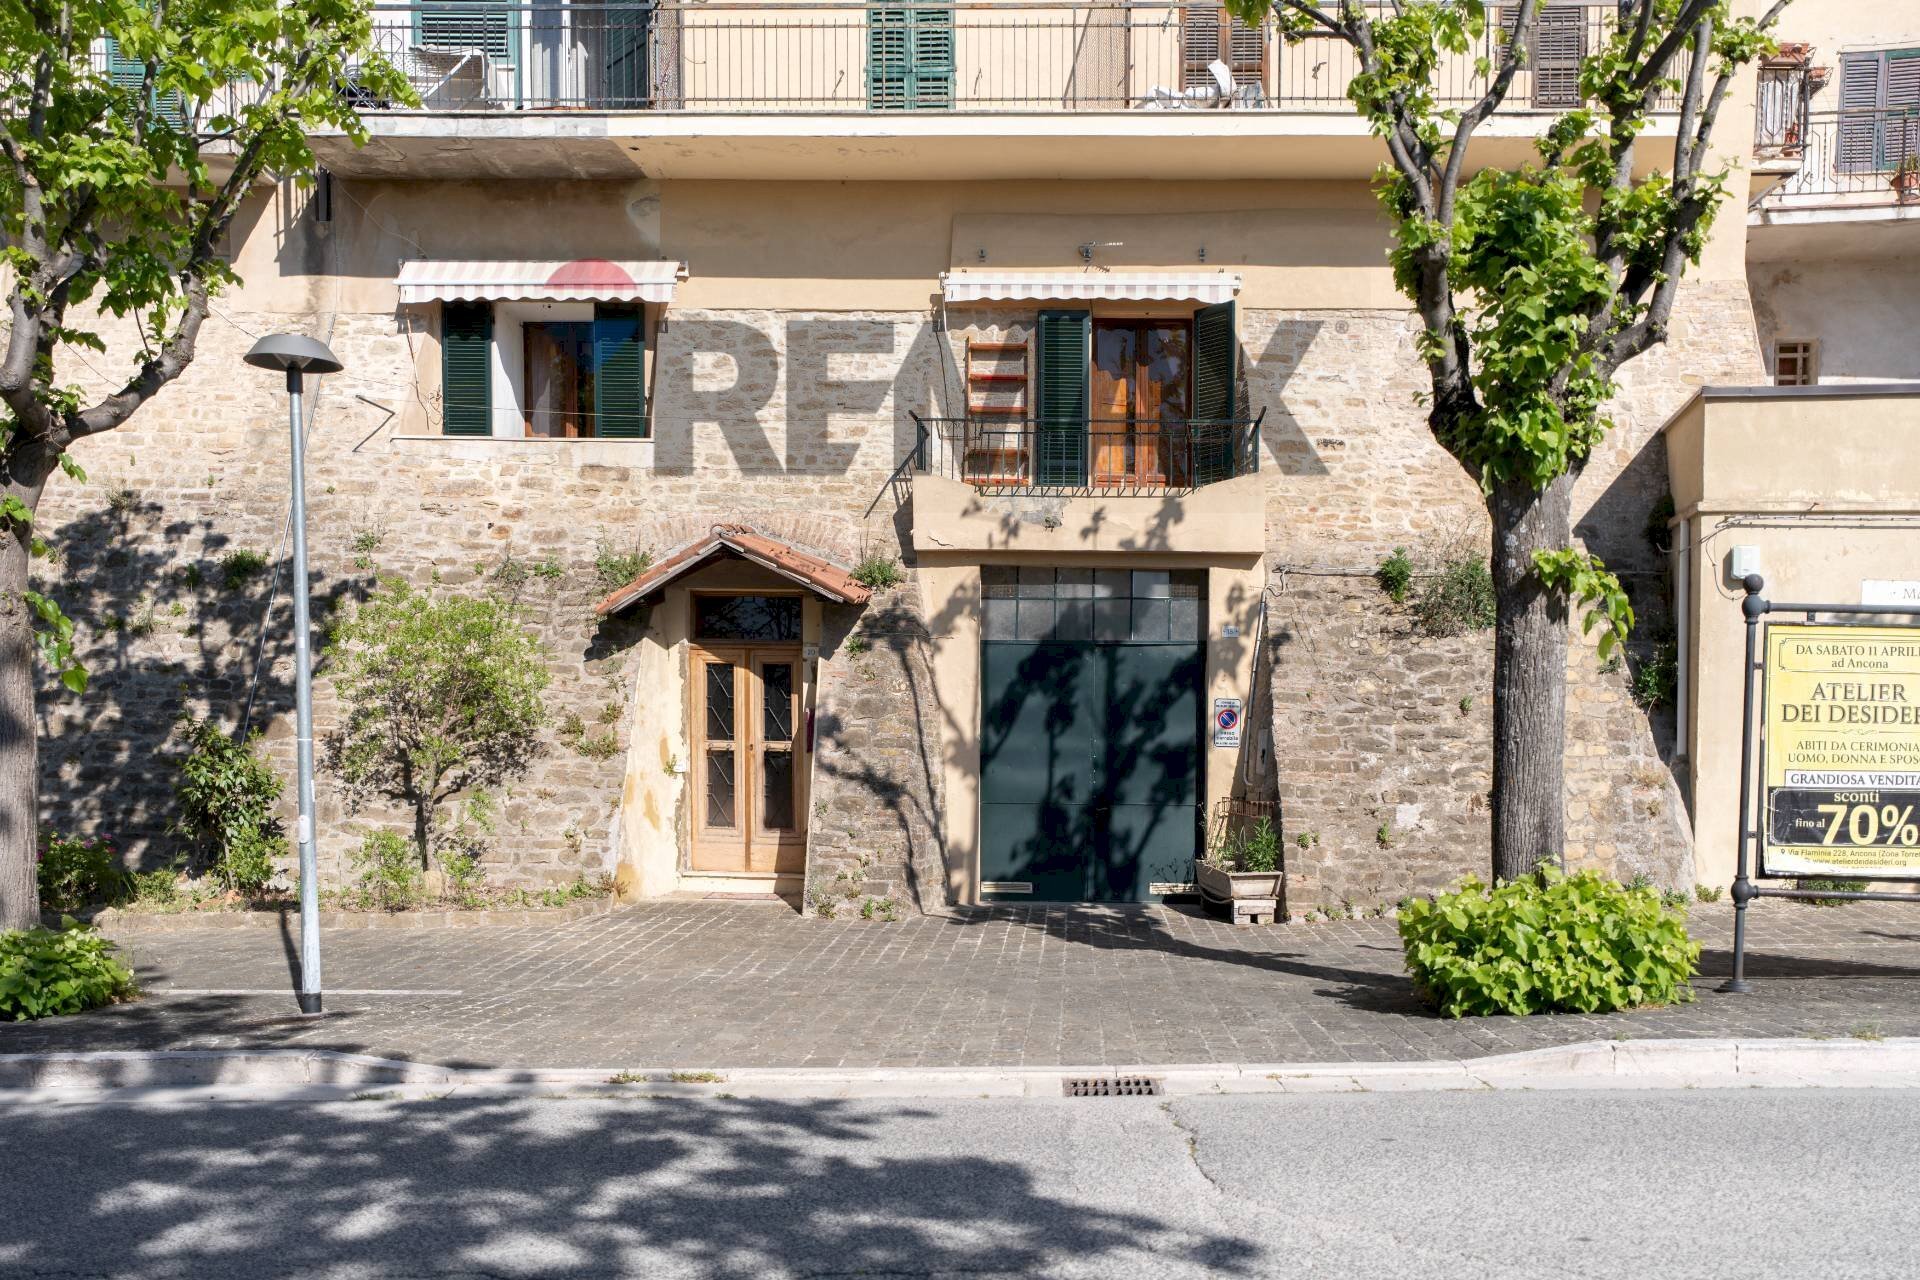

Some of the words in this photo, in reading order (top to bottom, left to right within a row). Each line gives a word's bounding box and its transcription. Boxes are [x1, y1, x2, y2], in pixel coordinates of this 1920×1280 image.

[1903, 588, 1920, 599] M
[1796, 644, 1813, 655] DA
[1816, 645, 1865, 656] SABATO
[1869, 646, 1877, 656] 11
[1881, 646, 1920, 657] APRIL
[1831, 658, 1845, 668] ad
[1847, 658, 1889, 669] Ancona
[1810, 681, 1908, 702] ATELIER
[1782, 703, 1821, 723] DEI
[1796, 740, 1828, 751] ABITI
[1831, 741, 1847, 751] DA
[1850, 741, 1920, 752] CERIMONIA
[1788, 753, 1829, 764] UOMO,
[1831, 754, 1877, 764] DONNA
[1879, 754, 1887, 764] E
[1889, 754, 1920, 765] SPOS
[1790, 773, 1866, 785] GRANDIOSA
[1834, 789, 1880, 803] sconti
[1795, 818, 1815, 828] fino
[1816, 818, 1825, 828] al
[1817, 804, 1919, 846] 70%
[1801, 849, 1832, 857] Flaminia
